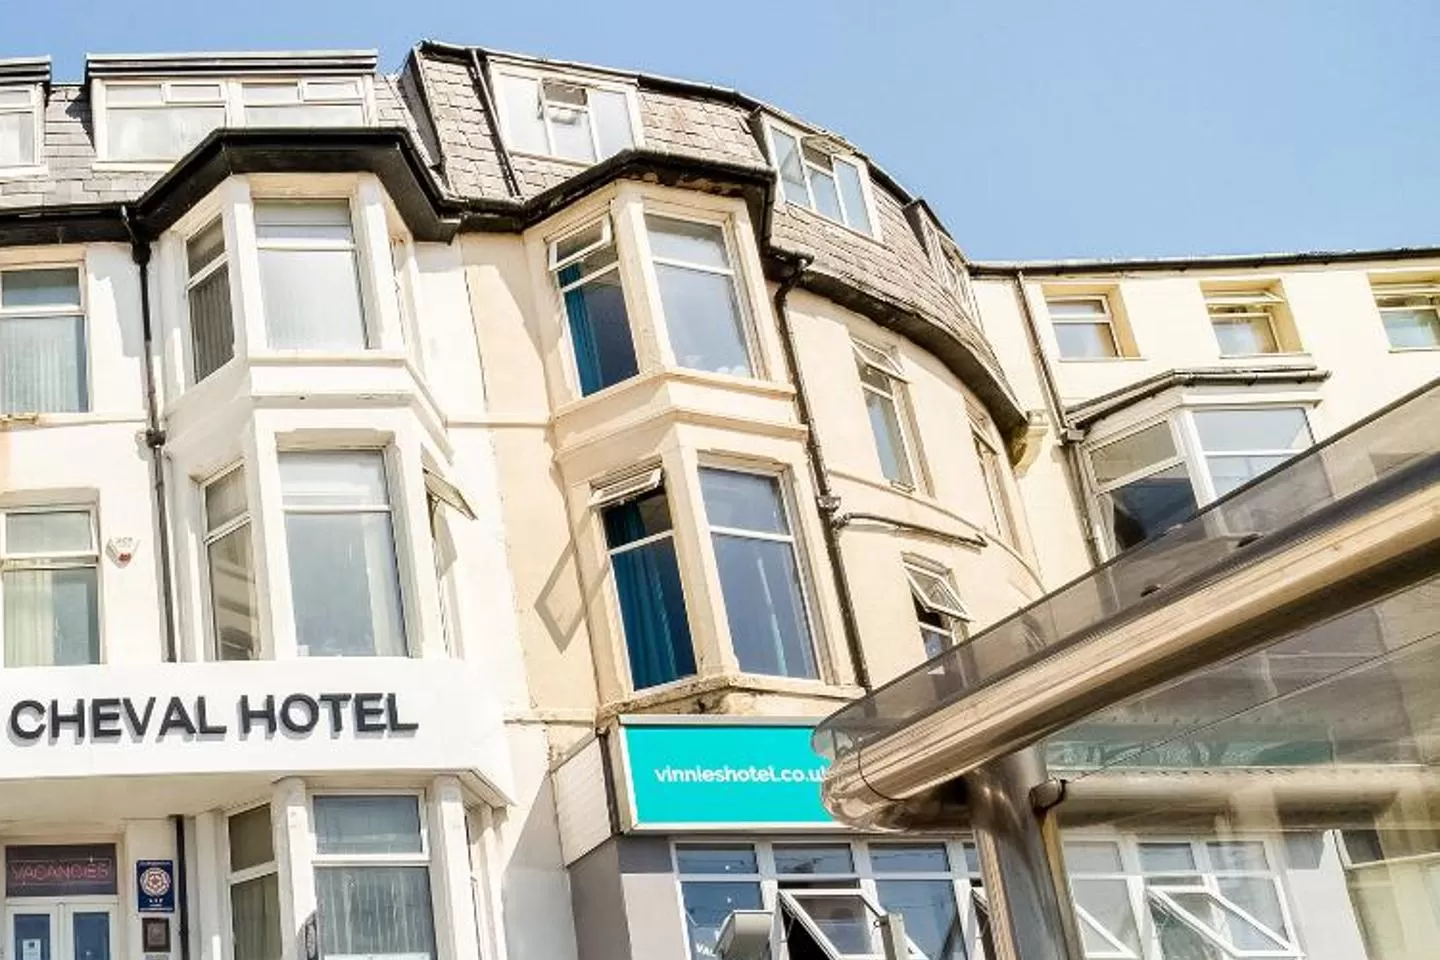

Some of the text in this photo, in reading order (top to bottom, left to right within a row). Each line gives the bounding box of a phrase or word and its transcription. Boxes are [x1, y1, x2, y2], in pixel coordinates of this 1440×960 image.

[10, 696, 227, 740] CHEVAL
[240, 693, 419, 735] HOTEL
[11, 862, 110, 881] VACANCIES
